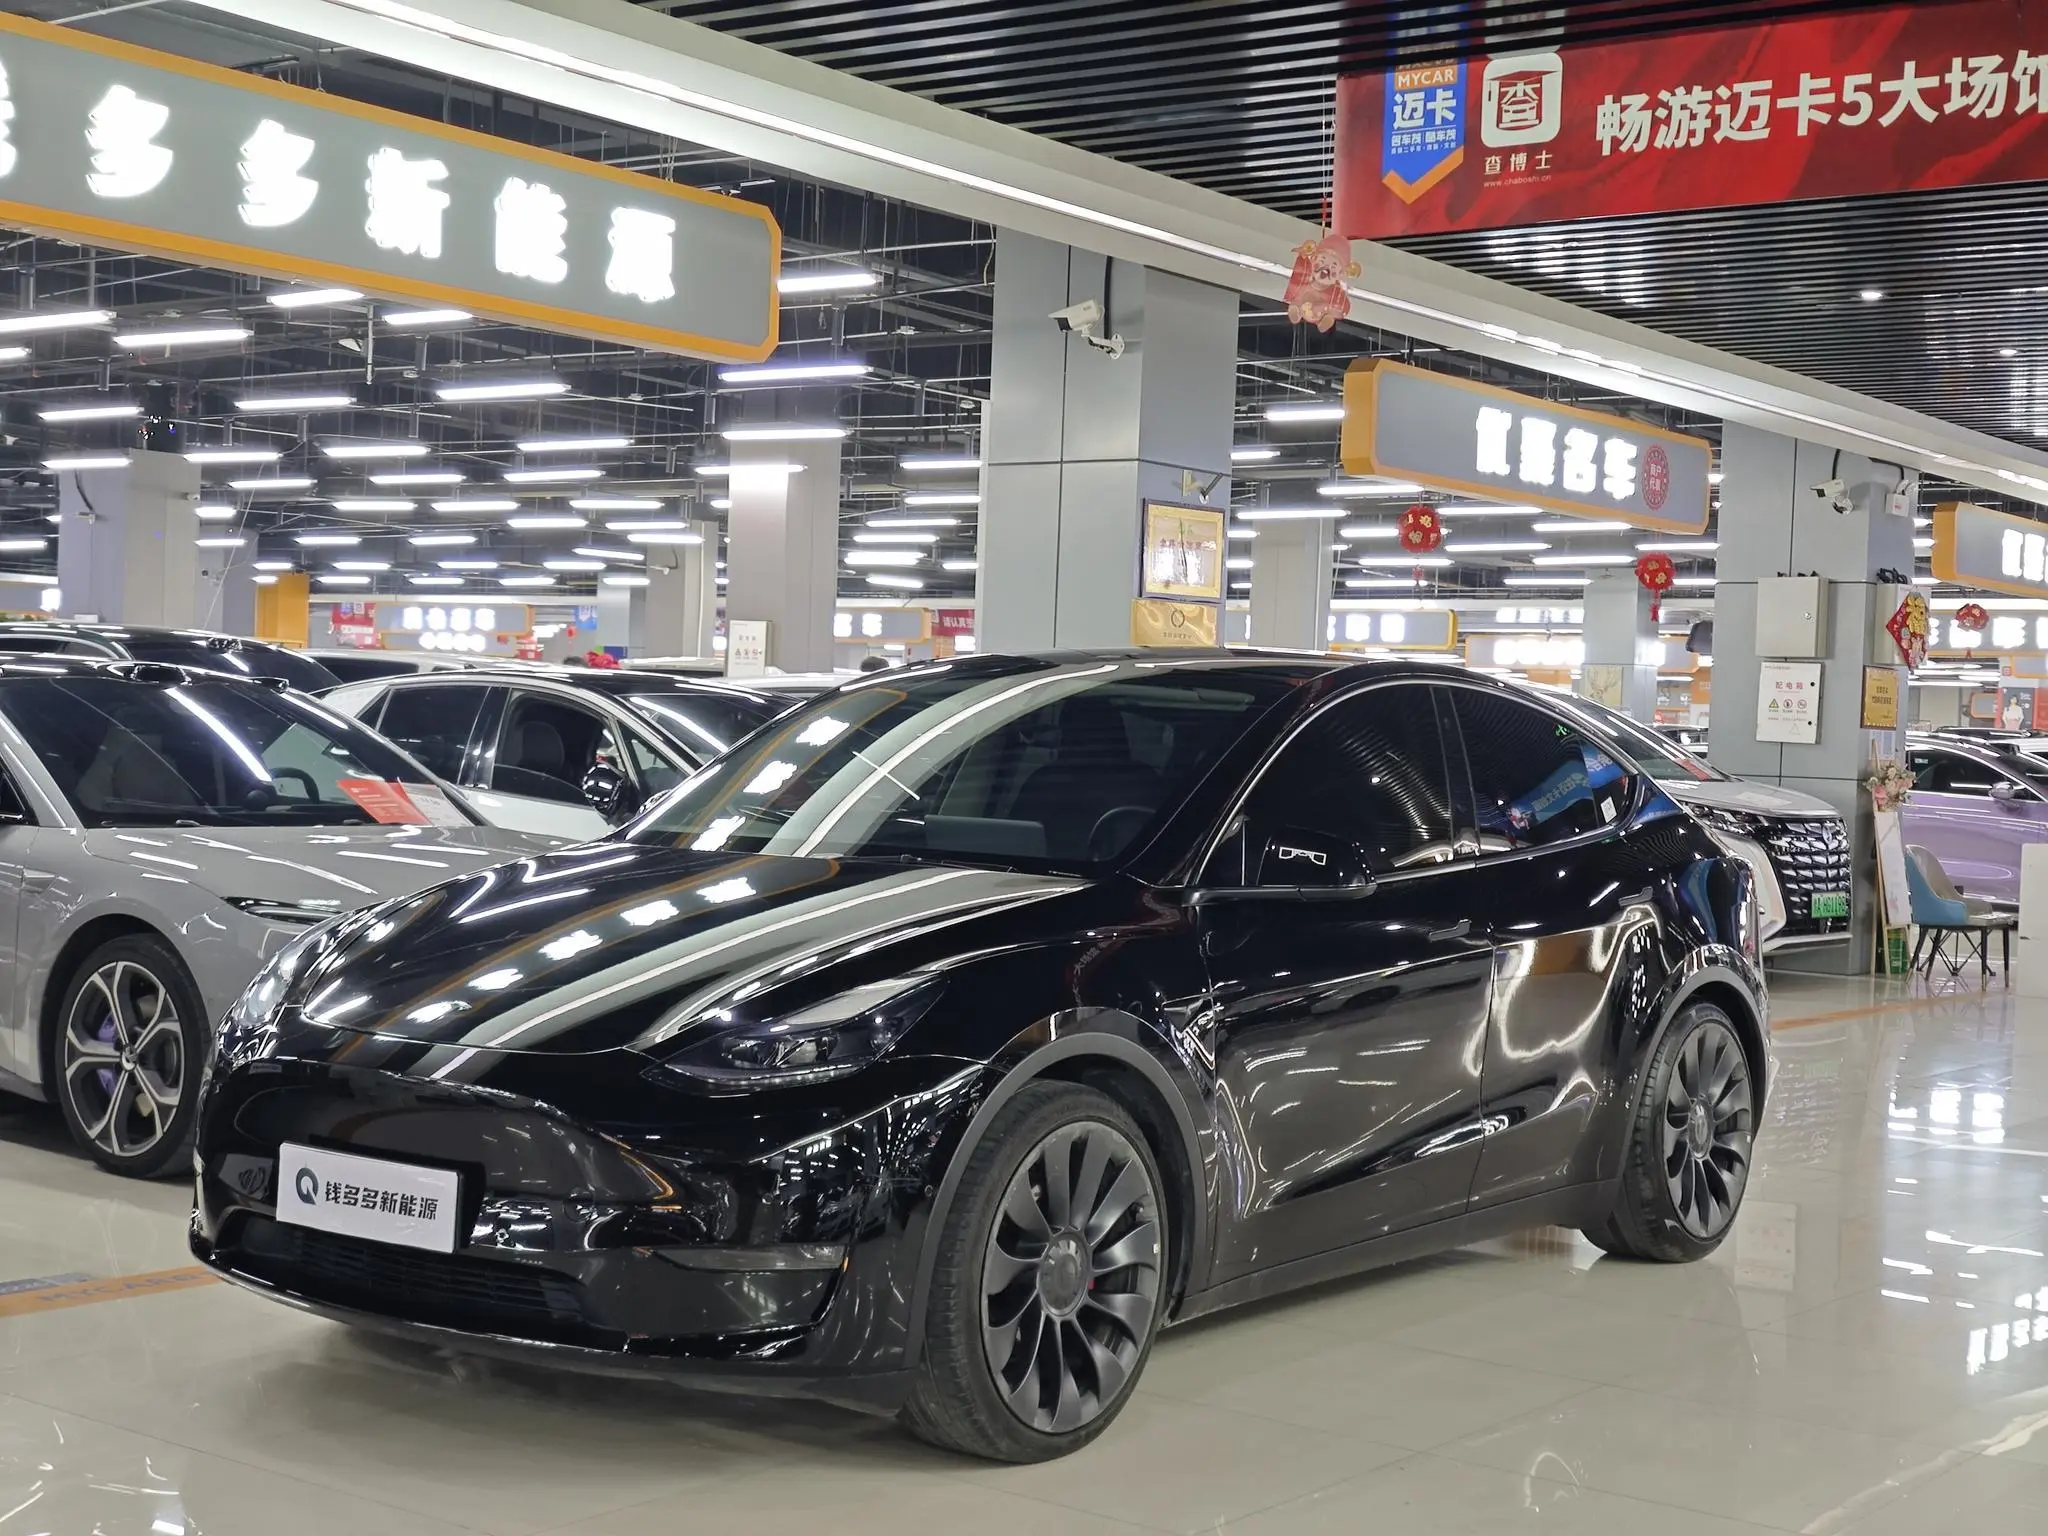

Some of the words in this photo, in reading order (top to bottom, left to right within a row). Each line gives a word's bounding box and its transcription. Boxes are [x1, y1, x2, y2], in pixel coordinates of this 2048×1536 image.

[1398, 69, 1454, 88] MYCAR
[1392, 88, 1457, 130] 迈卡
[1484, 150, 1553, 175] 查博士
[325, 1181, 439, 1221] 钱多多新能源
